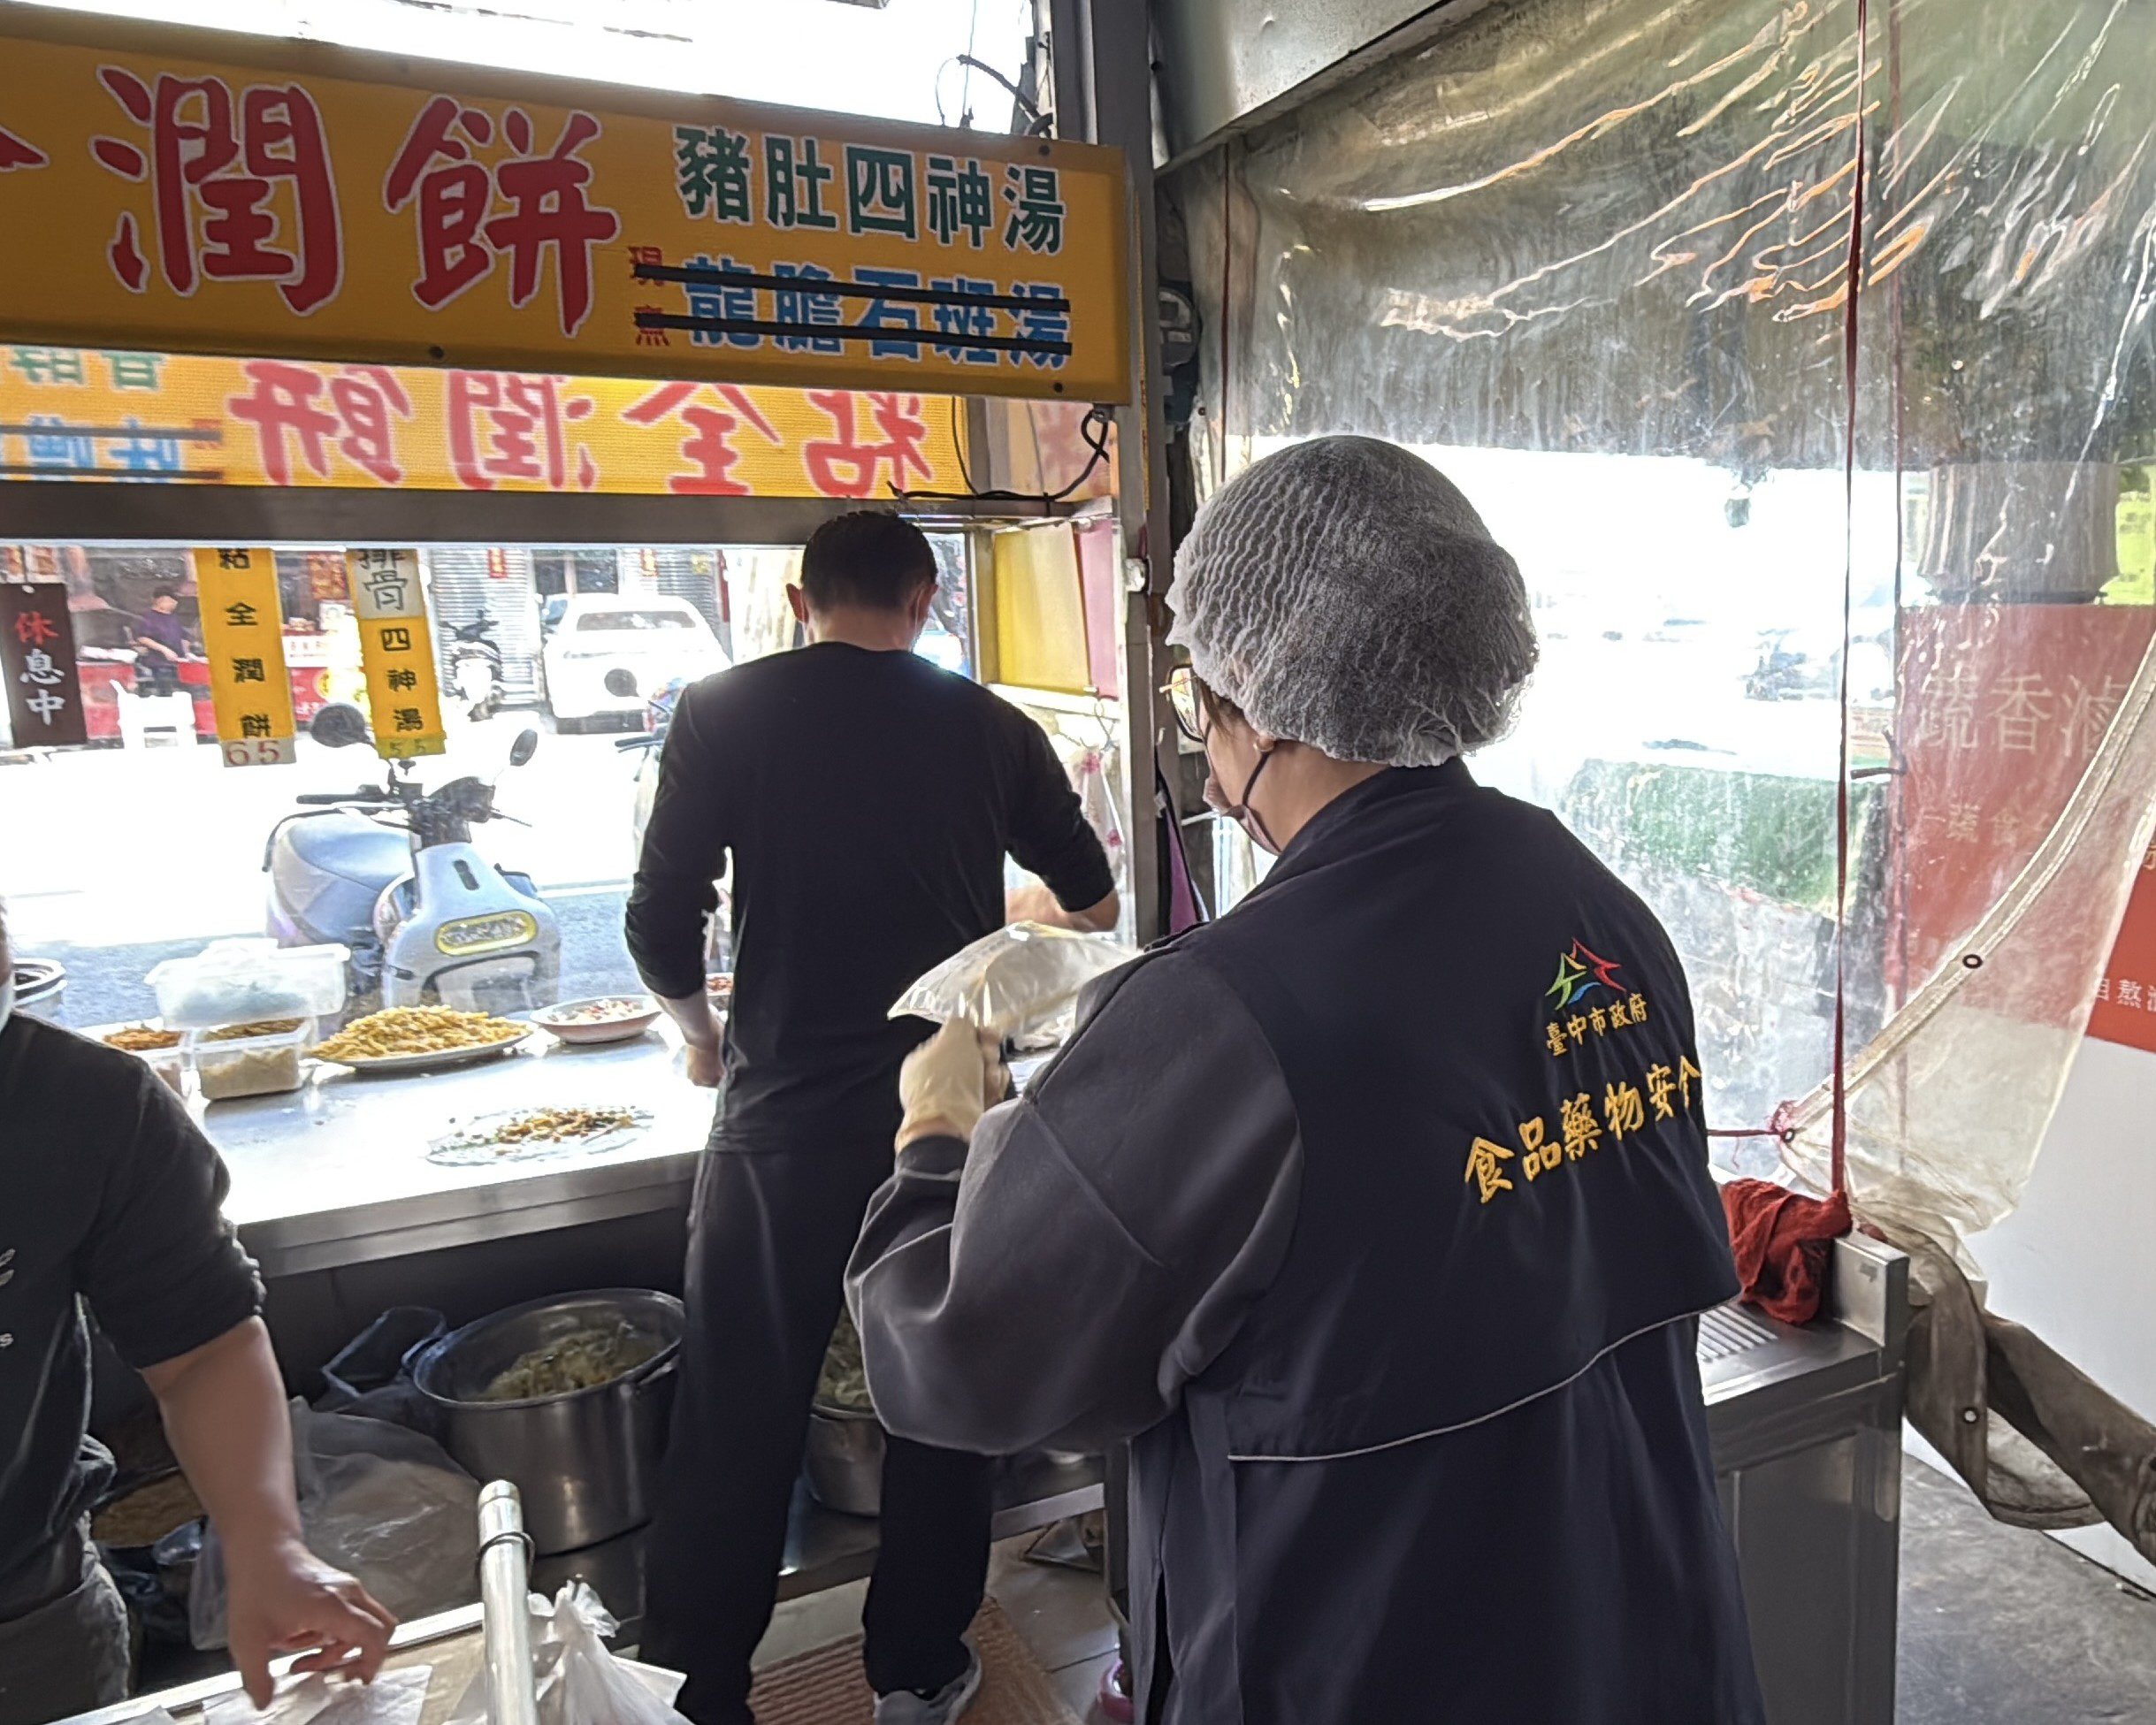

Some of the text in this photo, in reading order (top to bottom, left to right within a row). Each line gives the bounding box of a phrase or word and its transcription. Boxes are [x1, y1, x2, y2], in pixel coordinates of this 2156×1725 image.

[0, 66, 617, 337] 潤餅
[671, 125, 1067, 255] 豬肚四神湯
[15, 612, 65, 726] 休息中
[226, 740, 281, 766] 65
[1546, 993, 1647, 1056] 臺中市政府
